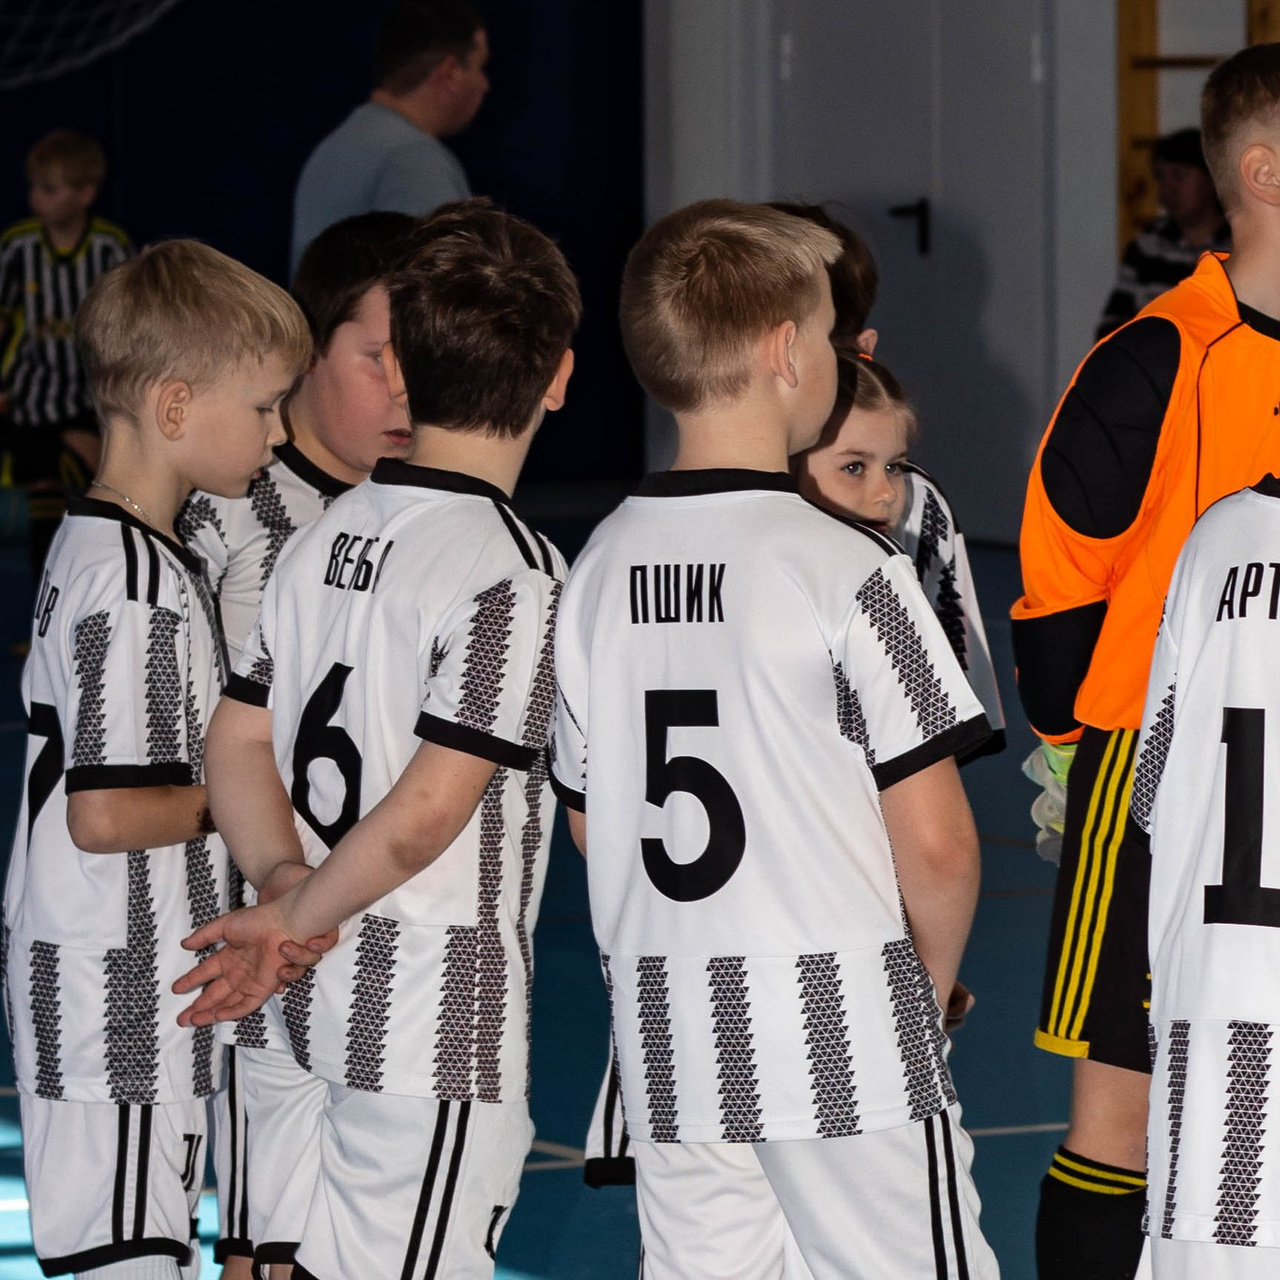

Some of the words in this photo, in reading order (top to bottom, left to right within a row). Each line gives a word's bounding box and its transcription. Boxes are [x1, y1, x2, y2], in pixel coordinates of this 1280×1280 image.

[629, 563, 726, 625] ПШИК
[291, 662, 363, 852] 6
[640, 689, 746, 903] 5
